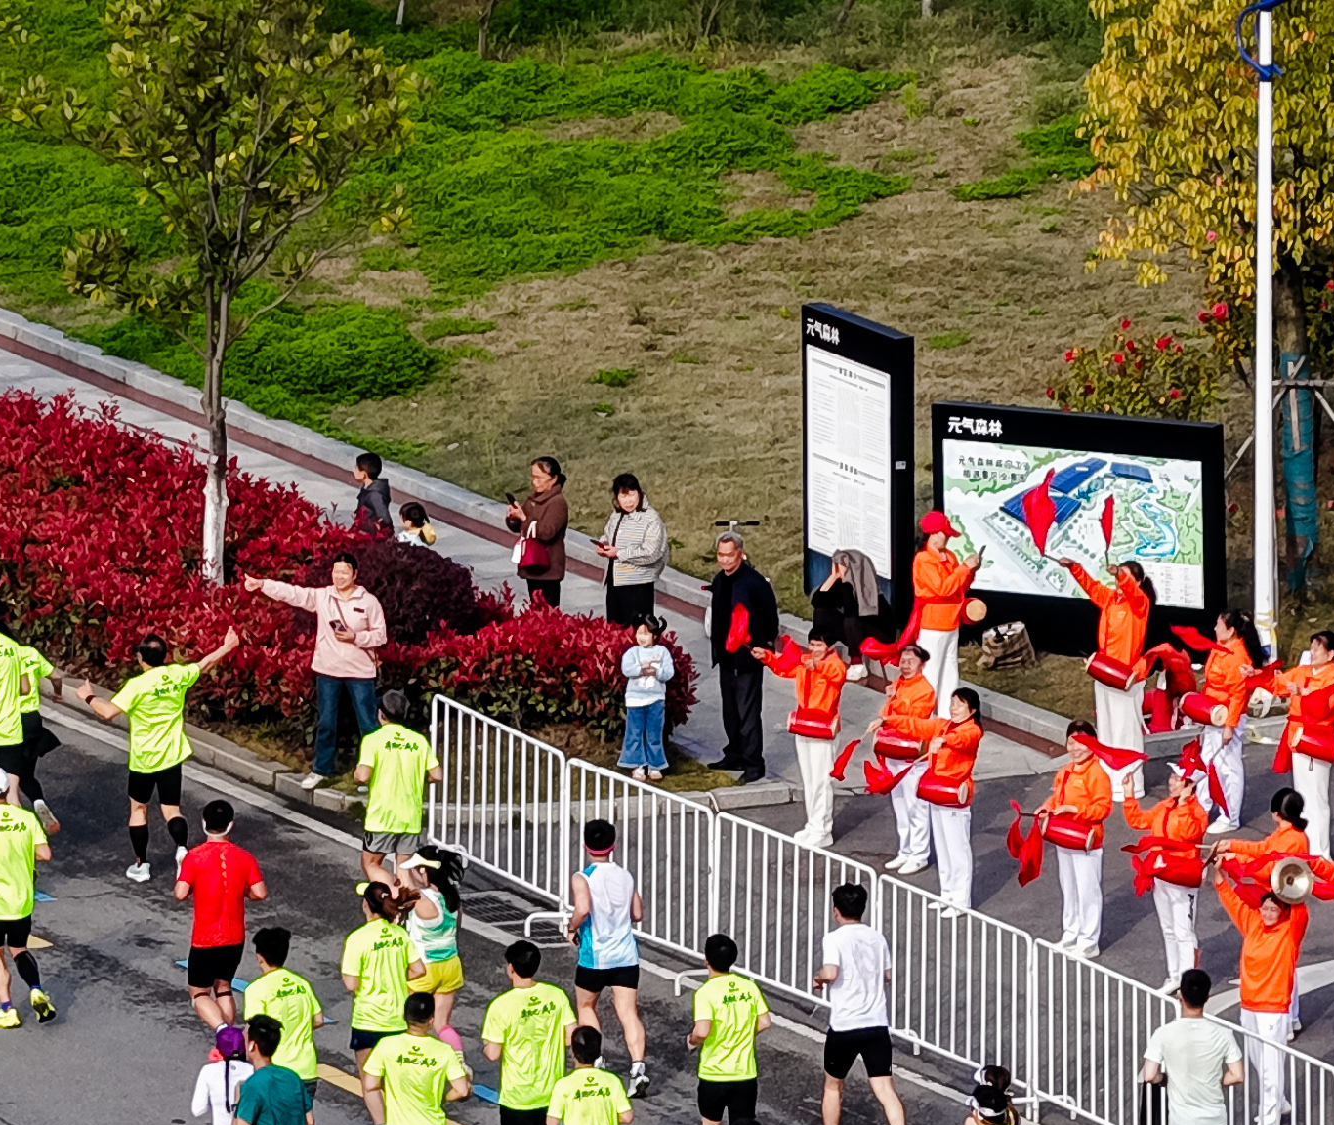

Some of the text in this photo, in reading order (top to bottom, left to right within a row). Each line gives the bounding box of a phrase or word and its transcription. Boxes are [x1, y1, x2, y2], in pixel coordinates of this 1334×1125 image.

[806, 318, 840, 345] 元气森林
[947, 416, 1003, 437] 元气森林
